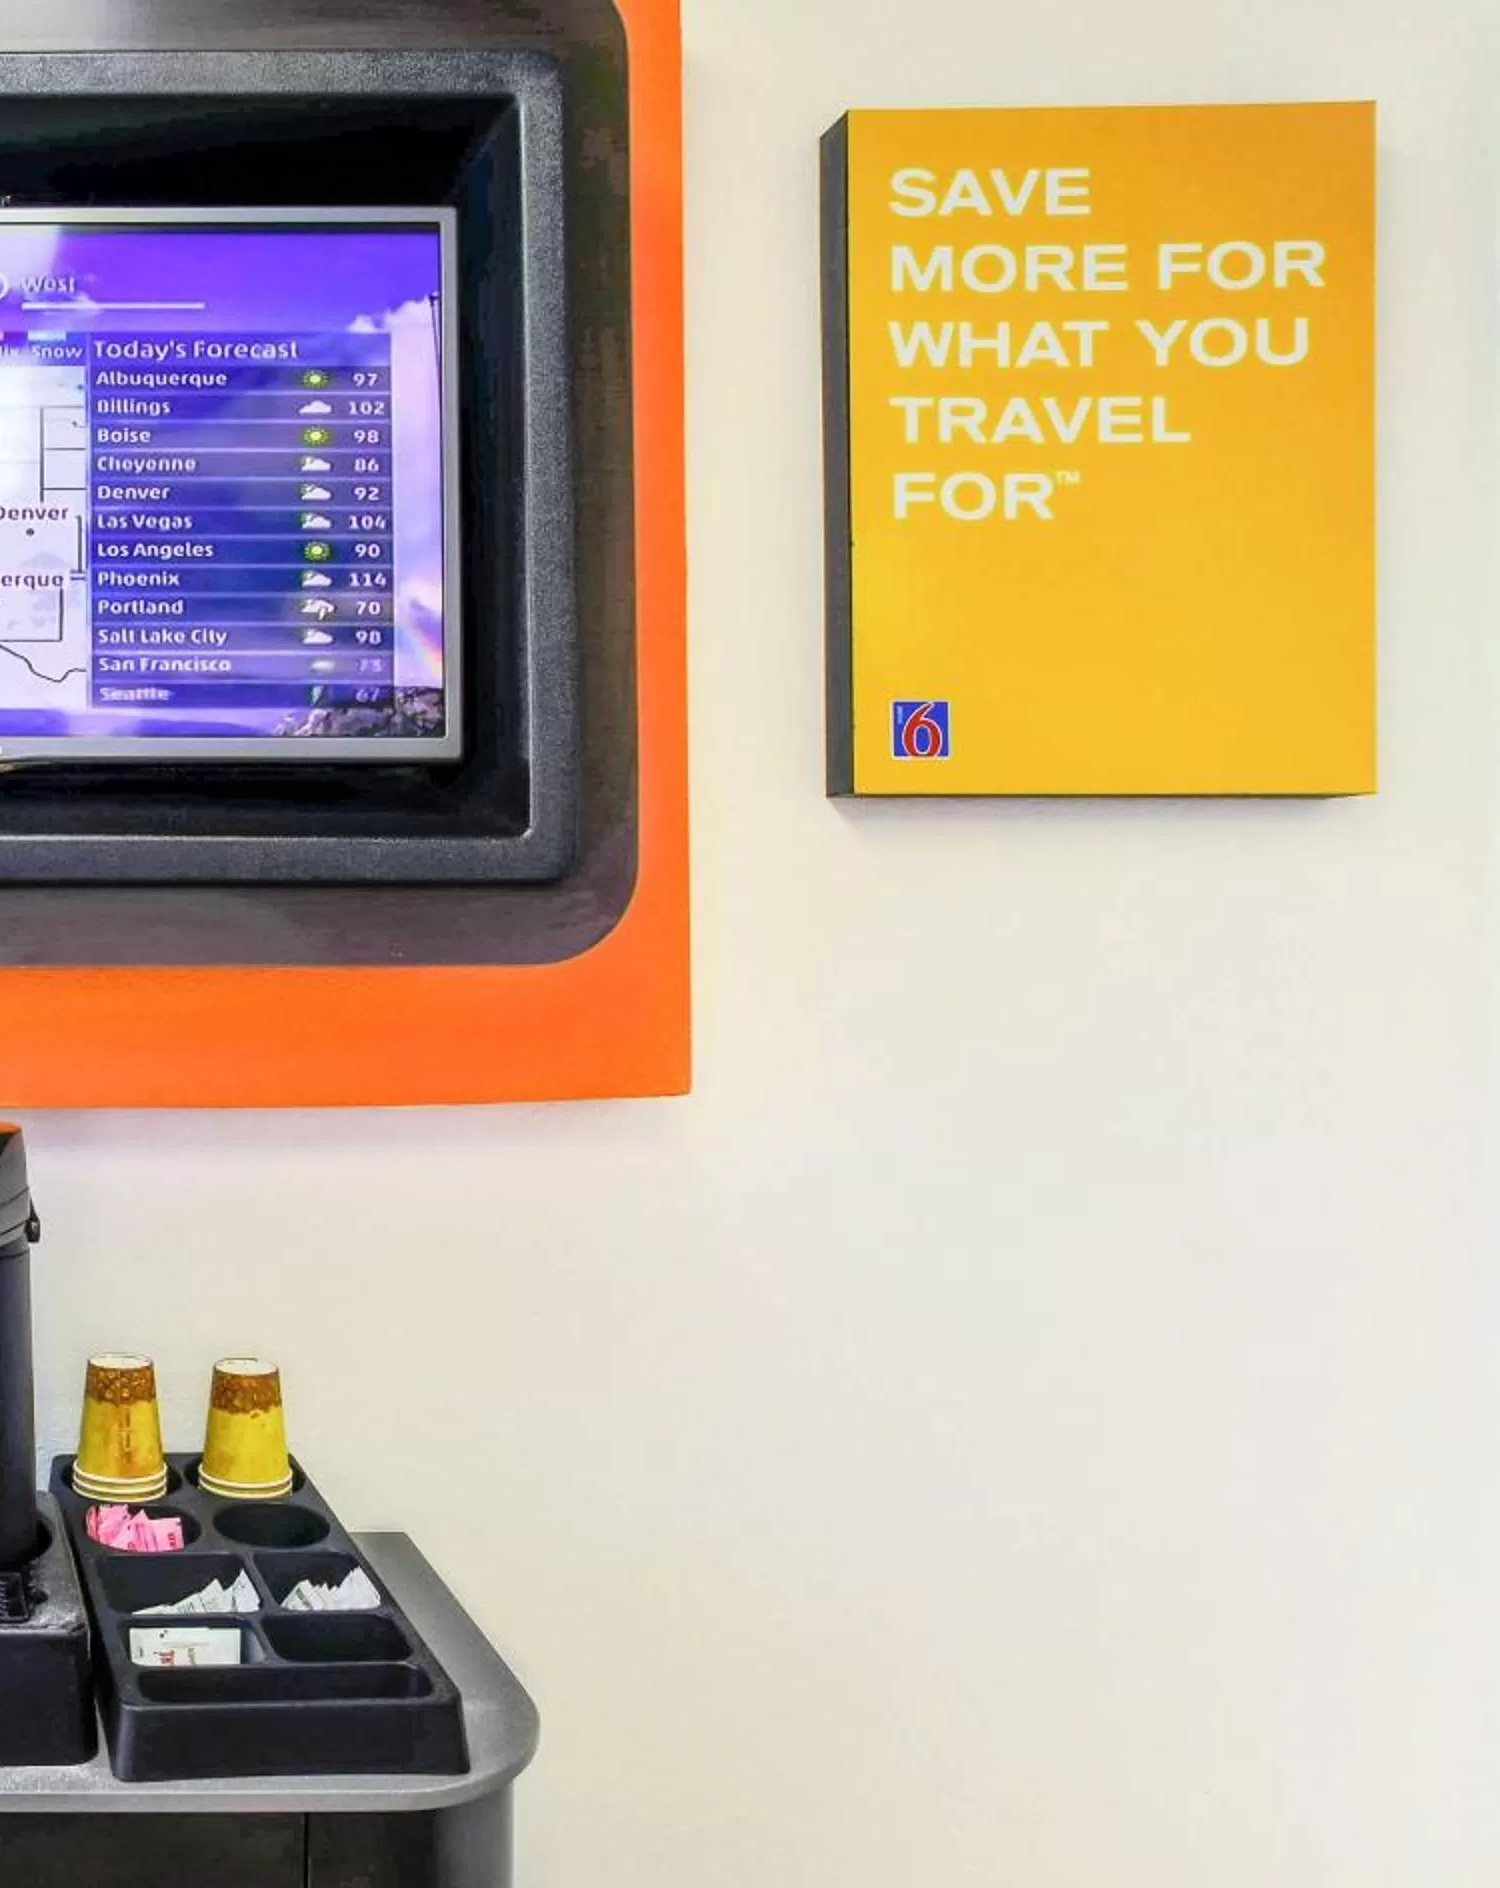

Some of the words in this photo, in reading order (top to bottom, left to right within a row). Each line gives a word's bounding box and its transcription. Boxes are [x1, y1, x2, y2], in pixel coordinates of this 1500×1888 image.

[890, 168, 1091, 217] SAVE
[890, 244, 1128, 292] MORE
[1158, 239, 1326, 290] FOR
[21, 275, 76, 294] West
[94, 340, 186, 361] Today's
[194, 341, 298, 359] Forecast
[888, 320, 1108, 368] WHAT
[1136, 318, 1310, 367] YOU
[31, 345, 82, 359] Snow
[96, 371, 228, 388] Albuquerque
[353, 373, 378, 387] 97
[97, 399, 171, 416] Billings
[348, 401, 385, 416] 102
[890, 396, 1190, 444] TRAVEL
[97, 428, 151, 442] Boise
[354, 429, 380, 444] 98
[97, 456, 196, 475] Cheyenne
[354, 458, 380, 472] 86
[98, 485, 171, 500] Denver
[354, 486, 380, 501] 92
[98, 514, 129, 529] Las
[132, 514, 193, 531] Vegas
[348, 515, 387, 530] 104
[97, 543, 130, 557] Los
[134, 543, 214, 561] Angeles
[355, 544, 381, 558] 90
[97, 572, 180, 586] Phoenix
[349, 573, 387, 588] 114
[98, 600, 184, 616] Portland
[356, 601, 381, 616] 70
[98, 629, 136, 645] Salt
[140, 629, 186, 645] Lake
[190, 629, 227, 648] City
[99, 657, 136, 672] San
[140, 656, 232, 672] Francisco
[99, 686, 171, 700] Seattle
[902, 701, 942, 757] 6
